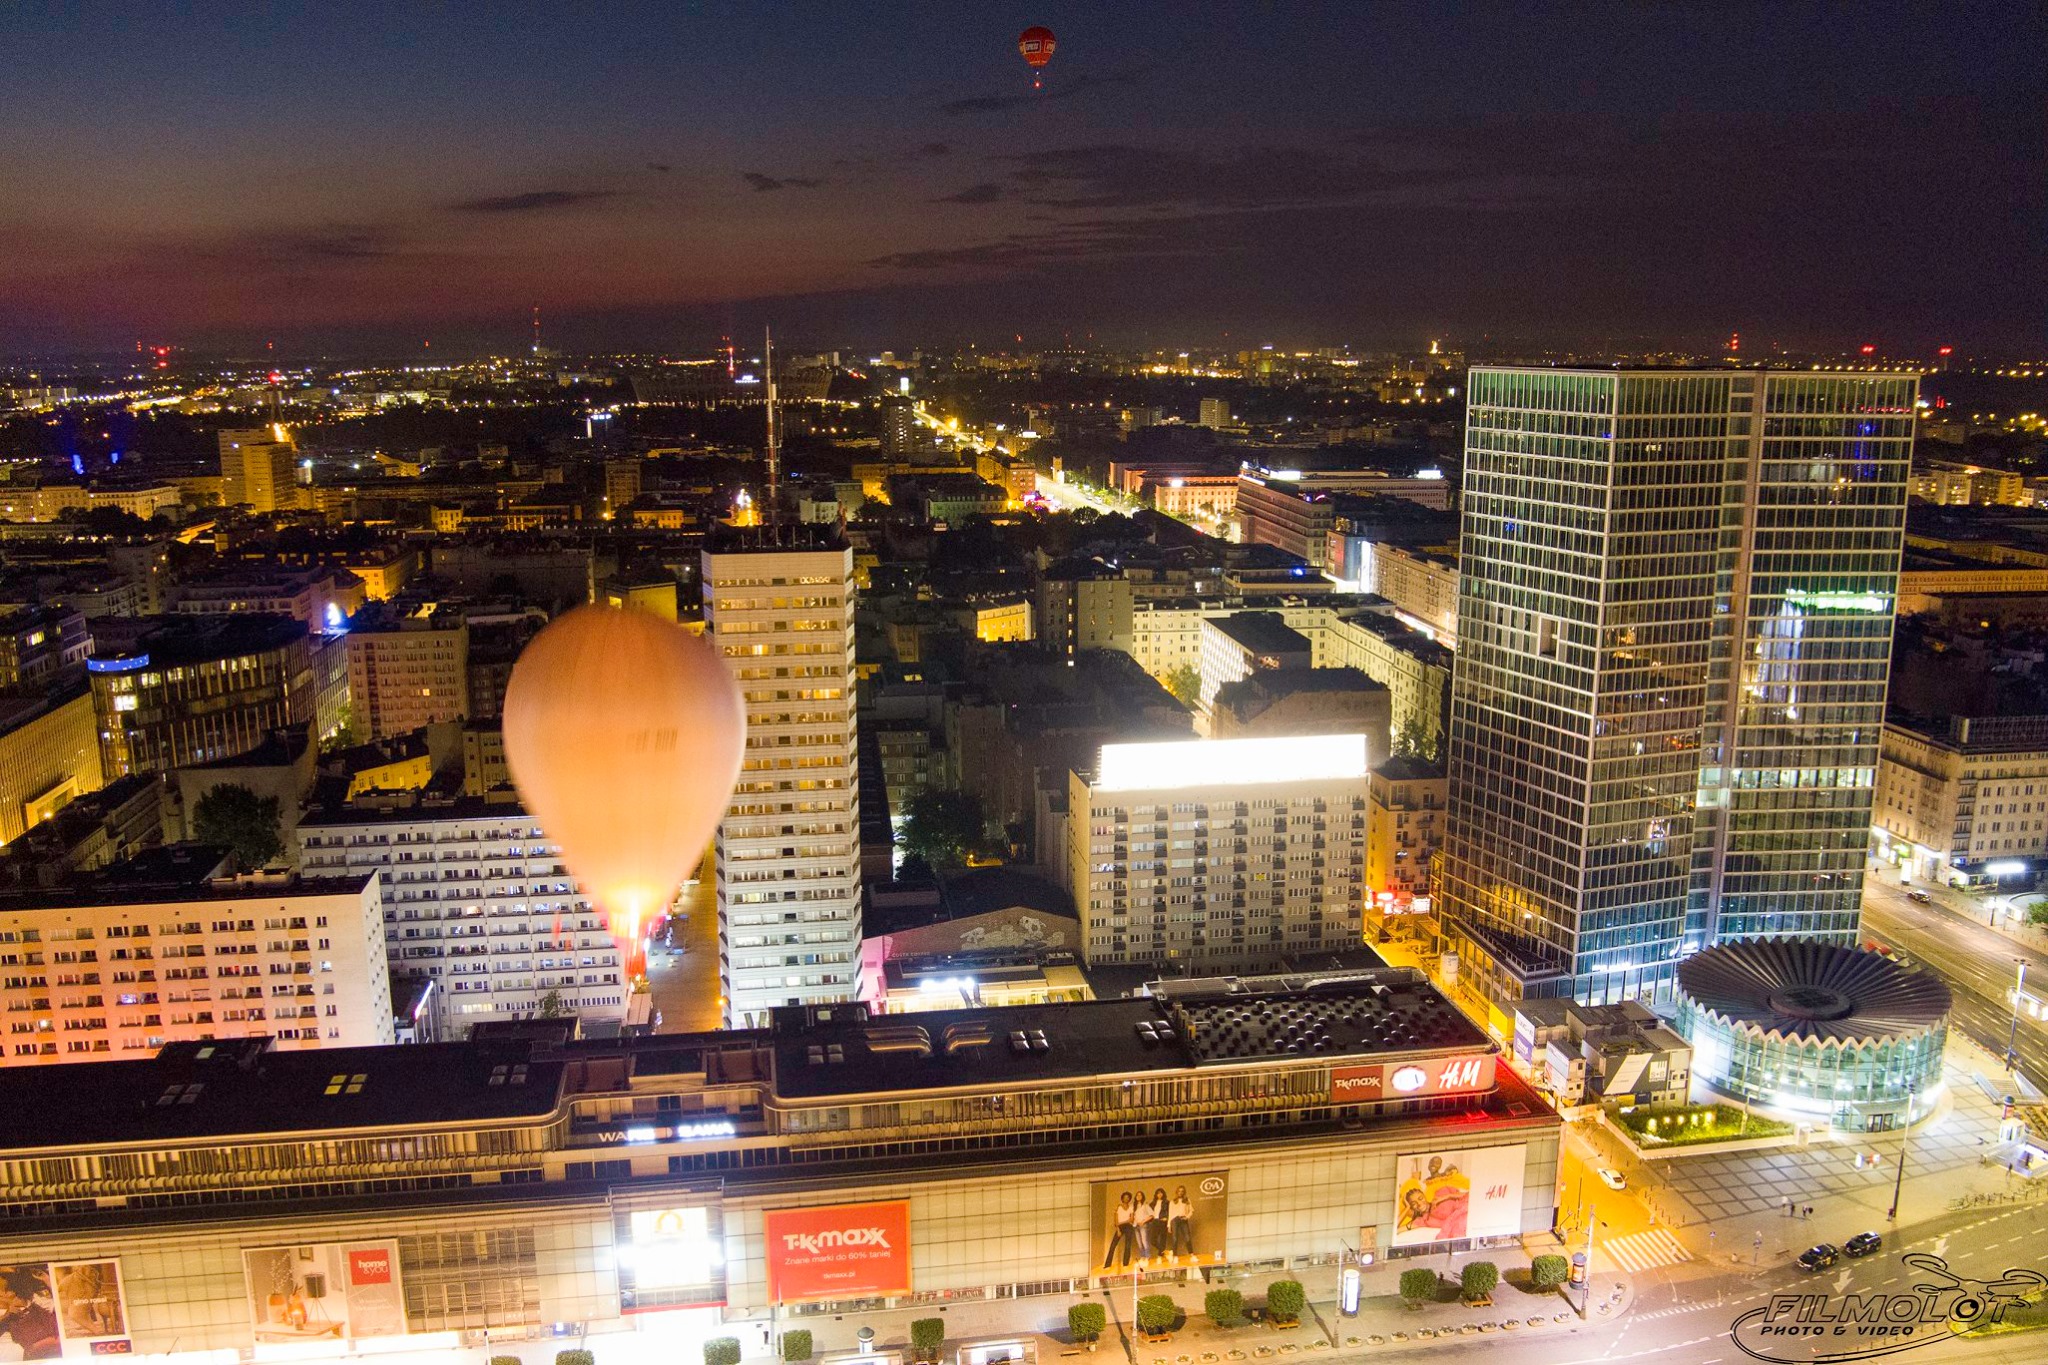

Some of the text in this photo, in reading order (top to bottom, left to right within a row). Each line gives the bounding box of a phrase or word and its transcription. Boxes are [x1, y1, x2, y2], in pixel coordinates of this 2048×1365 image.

[1438, 1060, 1482, 1090] H&M
[1484, 1184, 1509, 1201] H&M
[358, 1260, 388, 1269] home
[785, 1249, 891, 1266] Znane marki do 60% taniej
[823, 1271, 856, 1280] tkmaxx.pl
[73, 1296, 108, 1306] gino rossi
[95, 1341, 128, 1355] CCC
